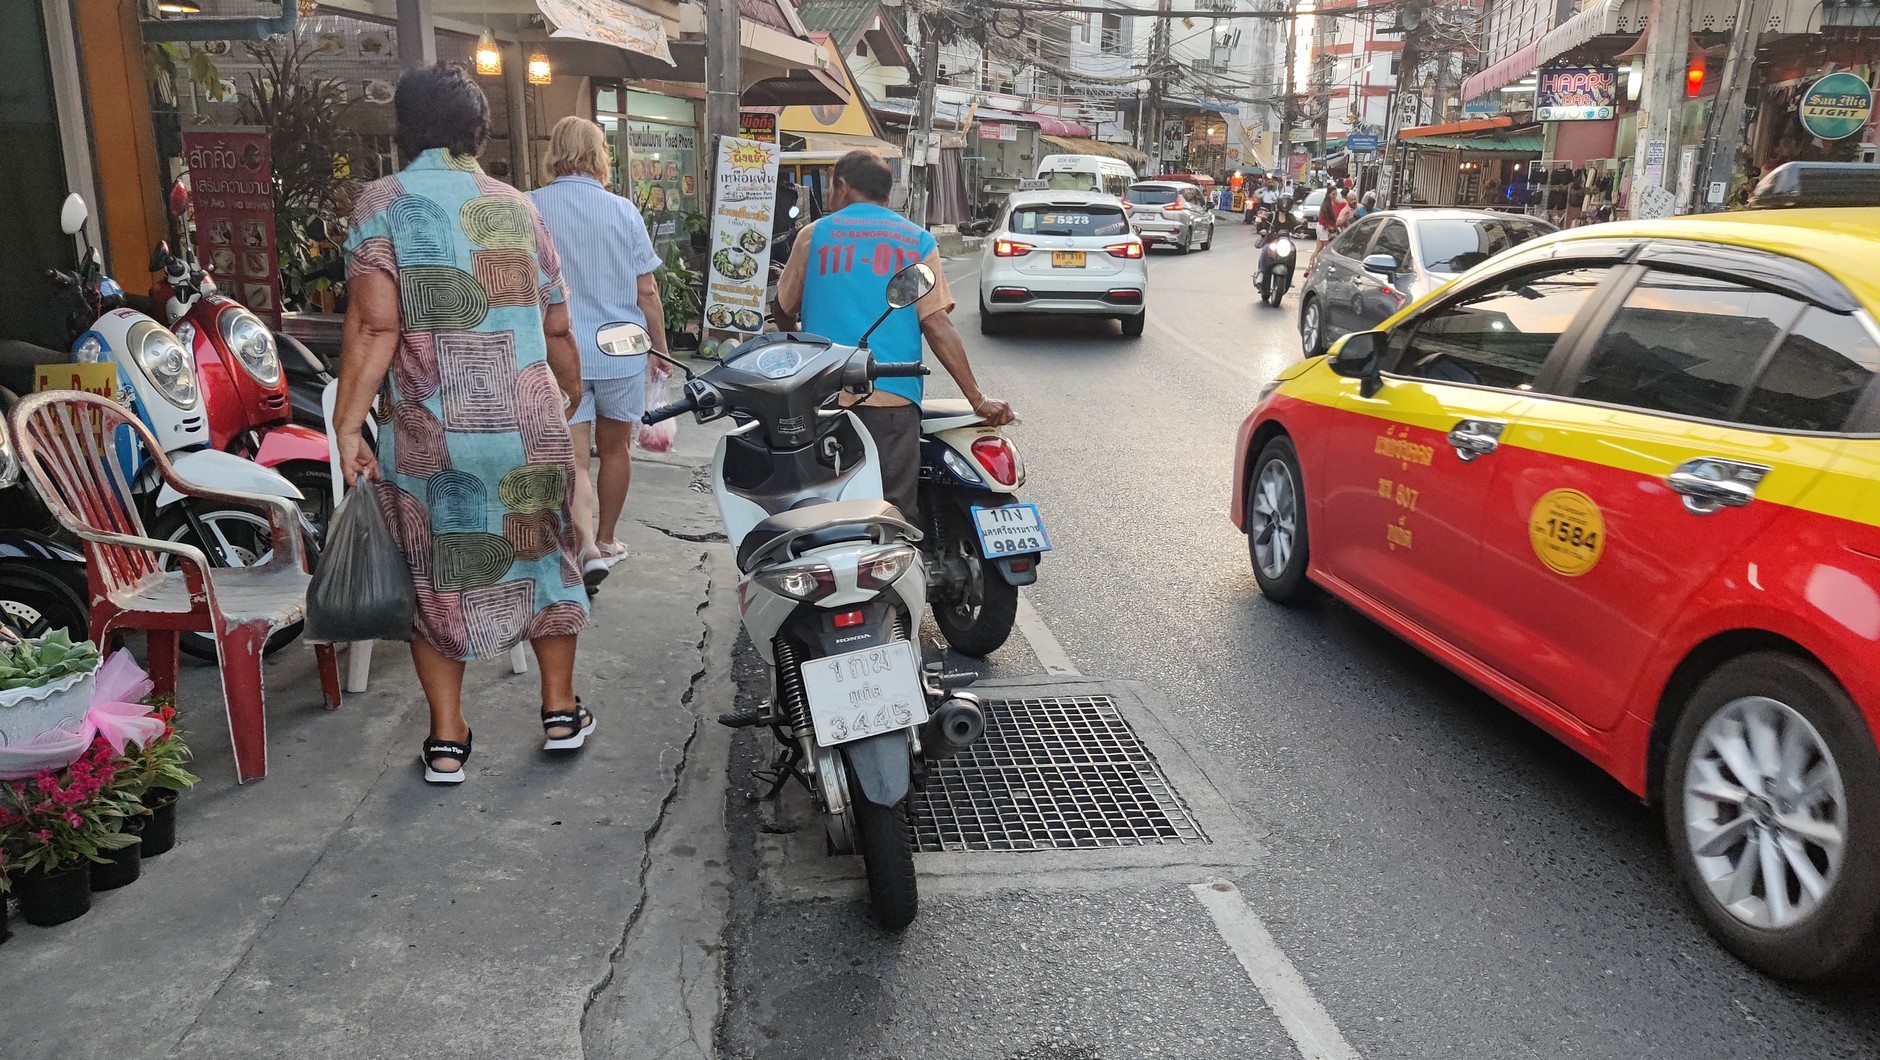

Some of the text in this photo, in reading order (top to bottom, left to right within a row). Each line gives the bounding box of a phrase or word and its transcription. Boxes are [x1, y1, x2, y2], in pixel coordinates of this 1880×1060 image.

[1541, 73, 1614, 93] HAPPY
[1562, 93, 1592, 106] BAR
[1808, 94, 1867, 108] San Mig
[1808, 107, 1858, 117] LIGHT
[679, 133, 694, 149] Phone
[190, 140, 236, 169] สักคิ้ว
[1023, 180, 1046, 188] TAXI
[830, 230, 846, 239] SOI
[1547, 518, 1598, 552] 1584
[993, 537, 1040, 553] 9843
[835, 633, 872, 644] HONDA
[849, 682, 882, 708] ภูเก็ต
[830, 701, 912, 740] 3445
